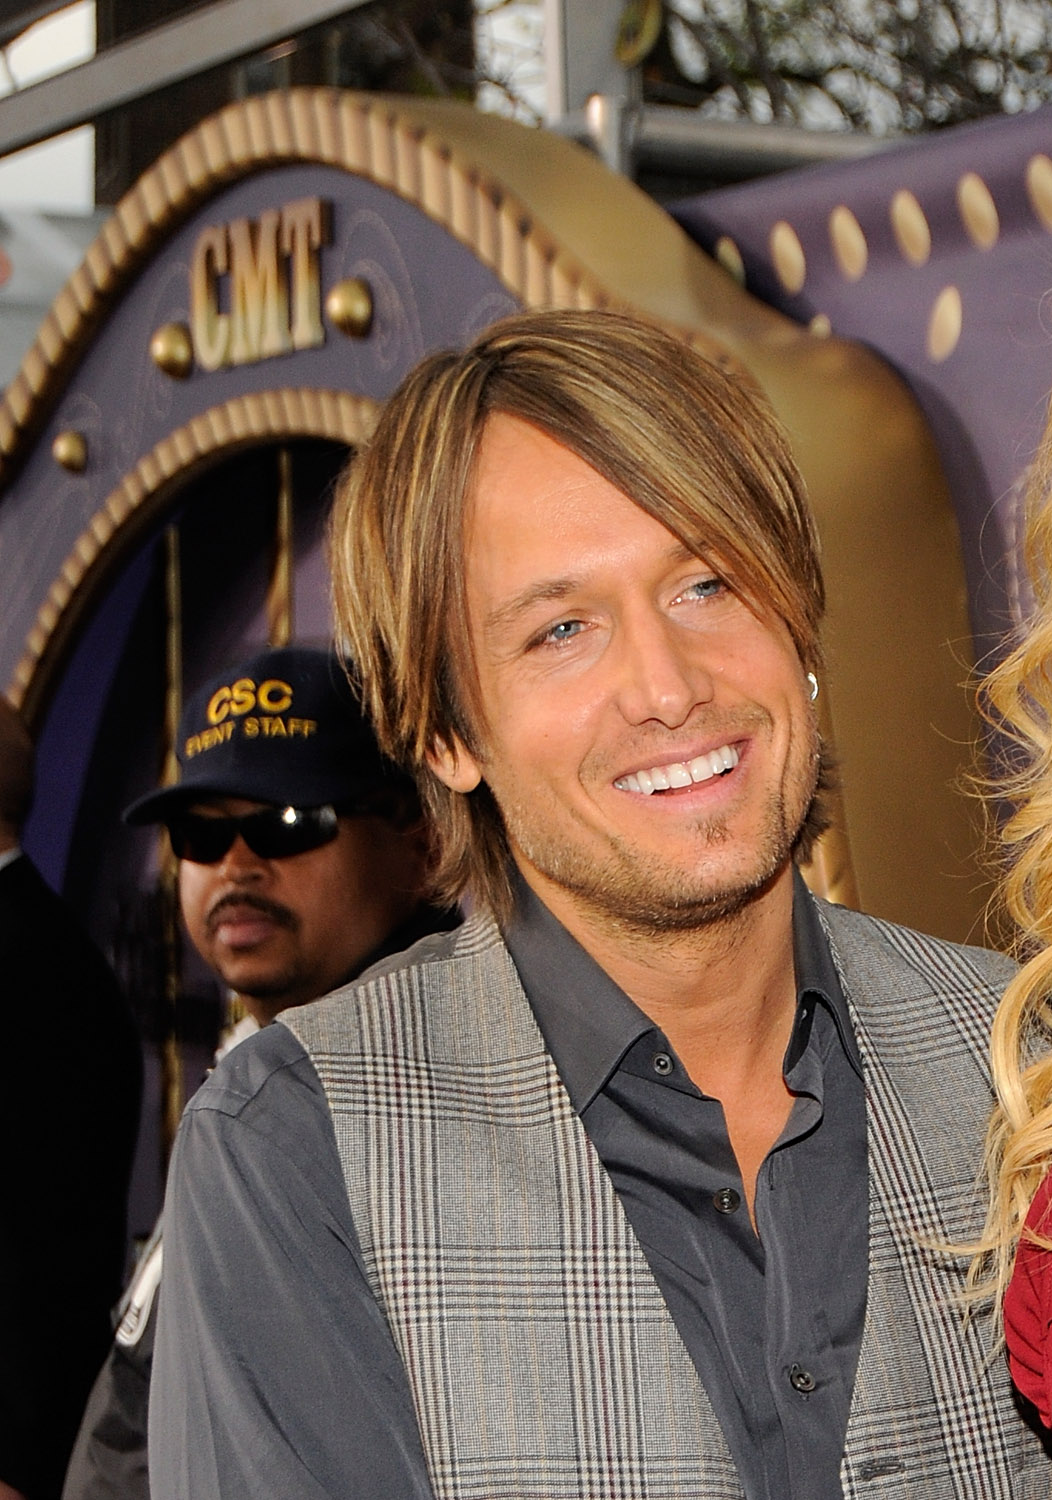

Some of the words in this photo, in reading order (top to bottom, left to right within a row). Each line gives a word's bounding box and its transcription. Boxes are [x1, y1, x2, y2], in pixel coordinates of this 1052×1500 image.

[191, 198, 331, 370] CMT
[207, 678, 293, 724] CSC
[186, 721, 236, 757] EVENT
[244, 717, 318, 738] STAFF
